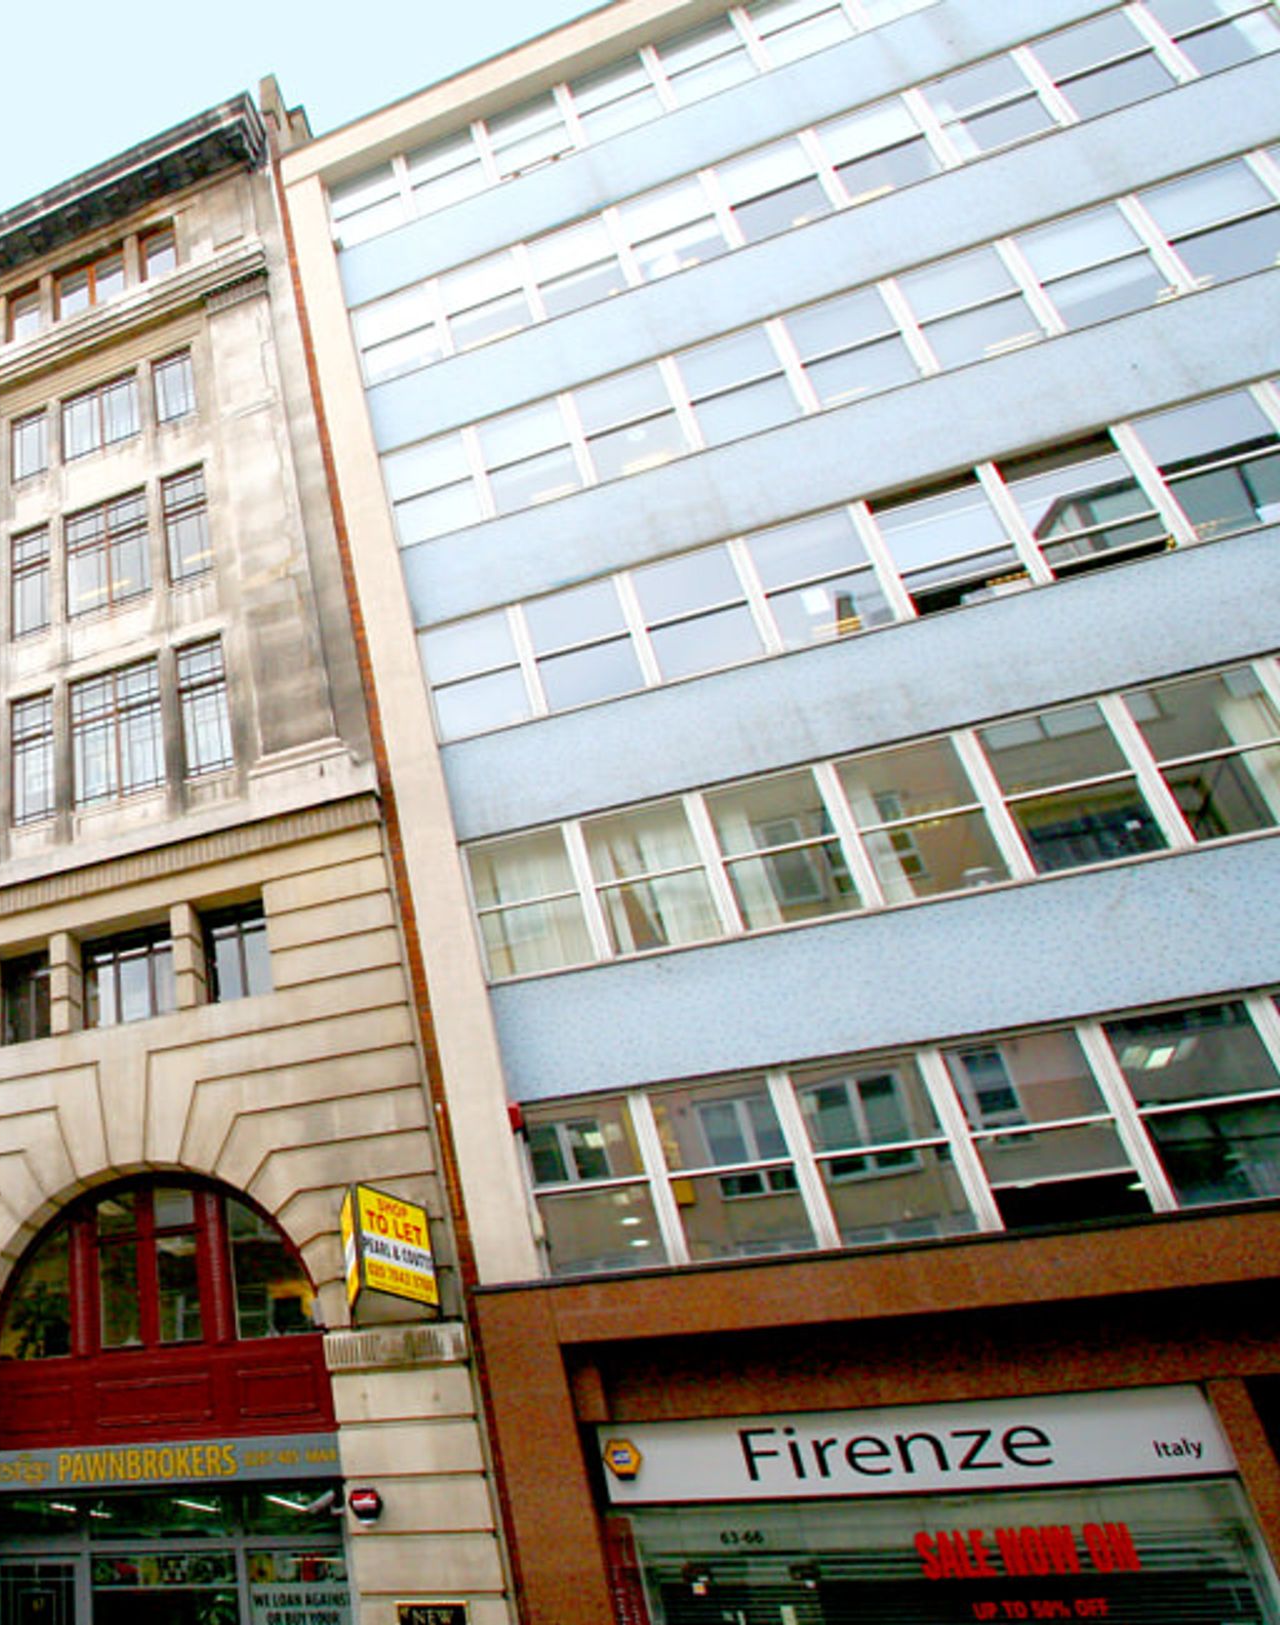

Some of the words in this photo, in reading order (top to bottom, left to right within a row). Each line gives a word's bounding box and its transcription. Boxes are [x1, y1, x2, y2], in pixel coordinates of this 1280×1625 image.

[376, 1197, 408, 1218] SHOP
[365, 1208, 389, 1234] TO
[392, 1217, 422, 1246] LET
[362, 1235, 391, 1259] PEARL
[392, 1244, 400, 1261] &
[57, 1442, 239, 1484] PAWNBROKERS
[737, 1422, 1054, 1482] Firenze
[1153, 1438, 1204, 1461] Italy
[720, 1529, 764, 1545] 63-66
[913, 1529, 997, 1580] SALE
[994, 1524, 1081, 1577] NOW
[1082, 1521, 1142, 1573] ON
[253, 1593, 270, 1607] WE
[272, 1592, 301, 1608] LOAN
[972, 1601, 999, 1620] UP
[1000, 1600, 1028, 1619] TO
[1030, 1599, 1070, 1619] 50%
[1074, 1597, 1110, 1617] OFF
[266, 1611, 282, 1625] OR
[285, 1611, 306, 1625] BUY
[309, 1610, 340, 1625] YOUR
[412, 1608, 453, 1625] NEW
